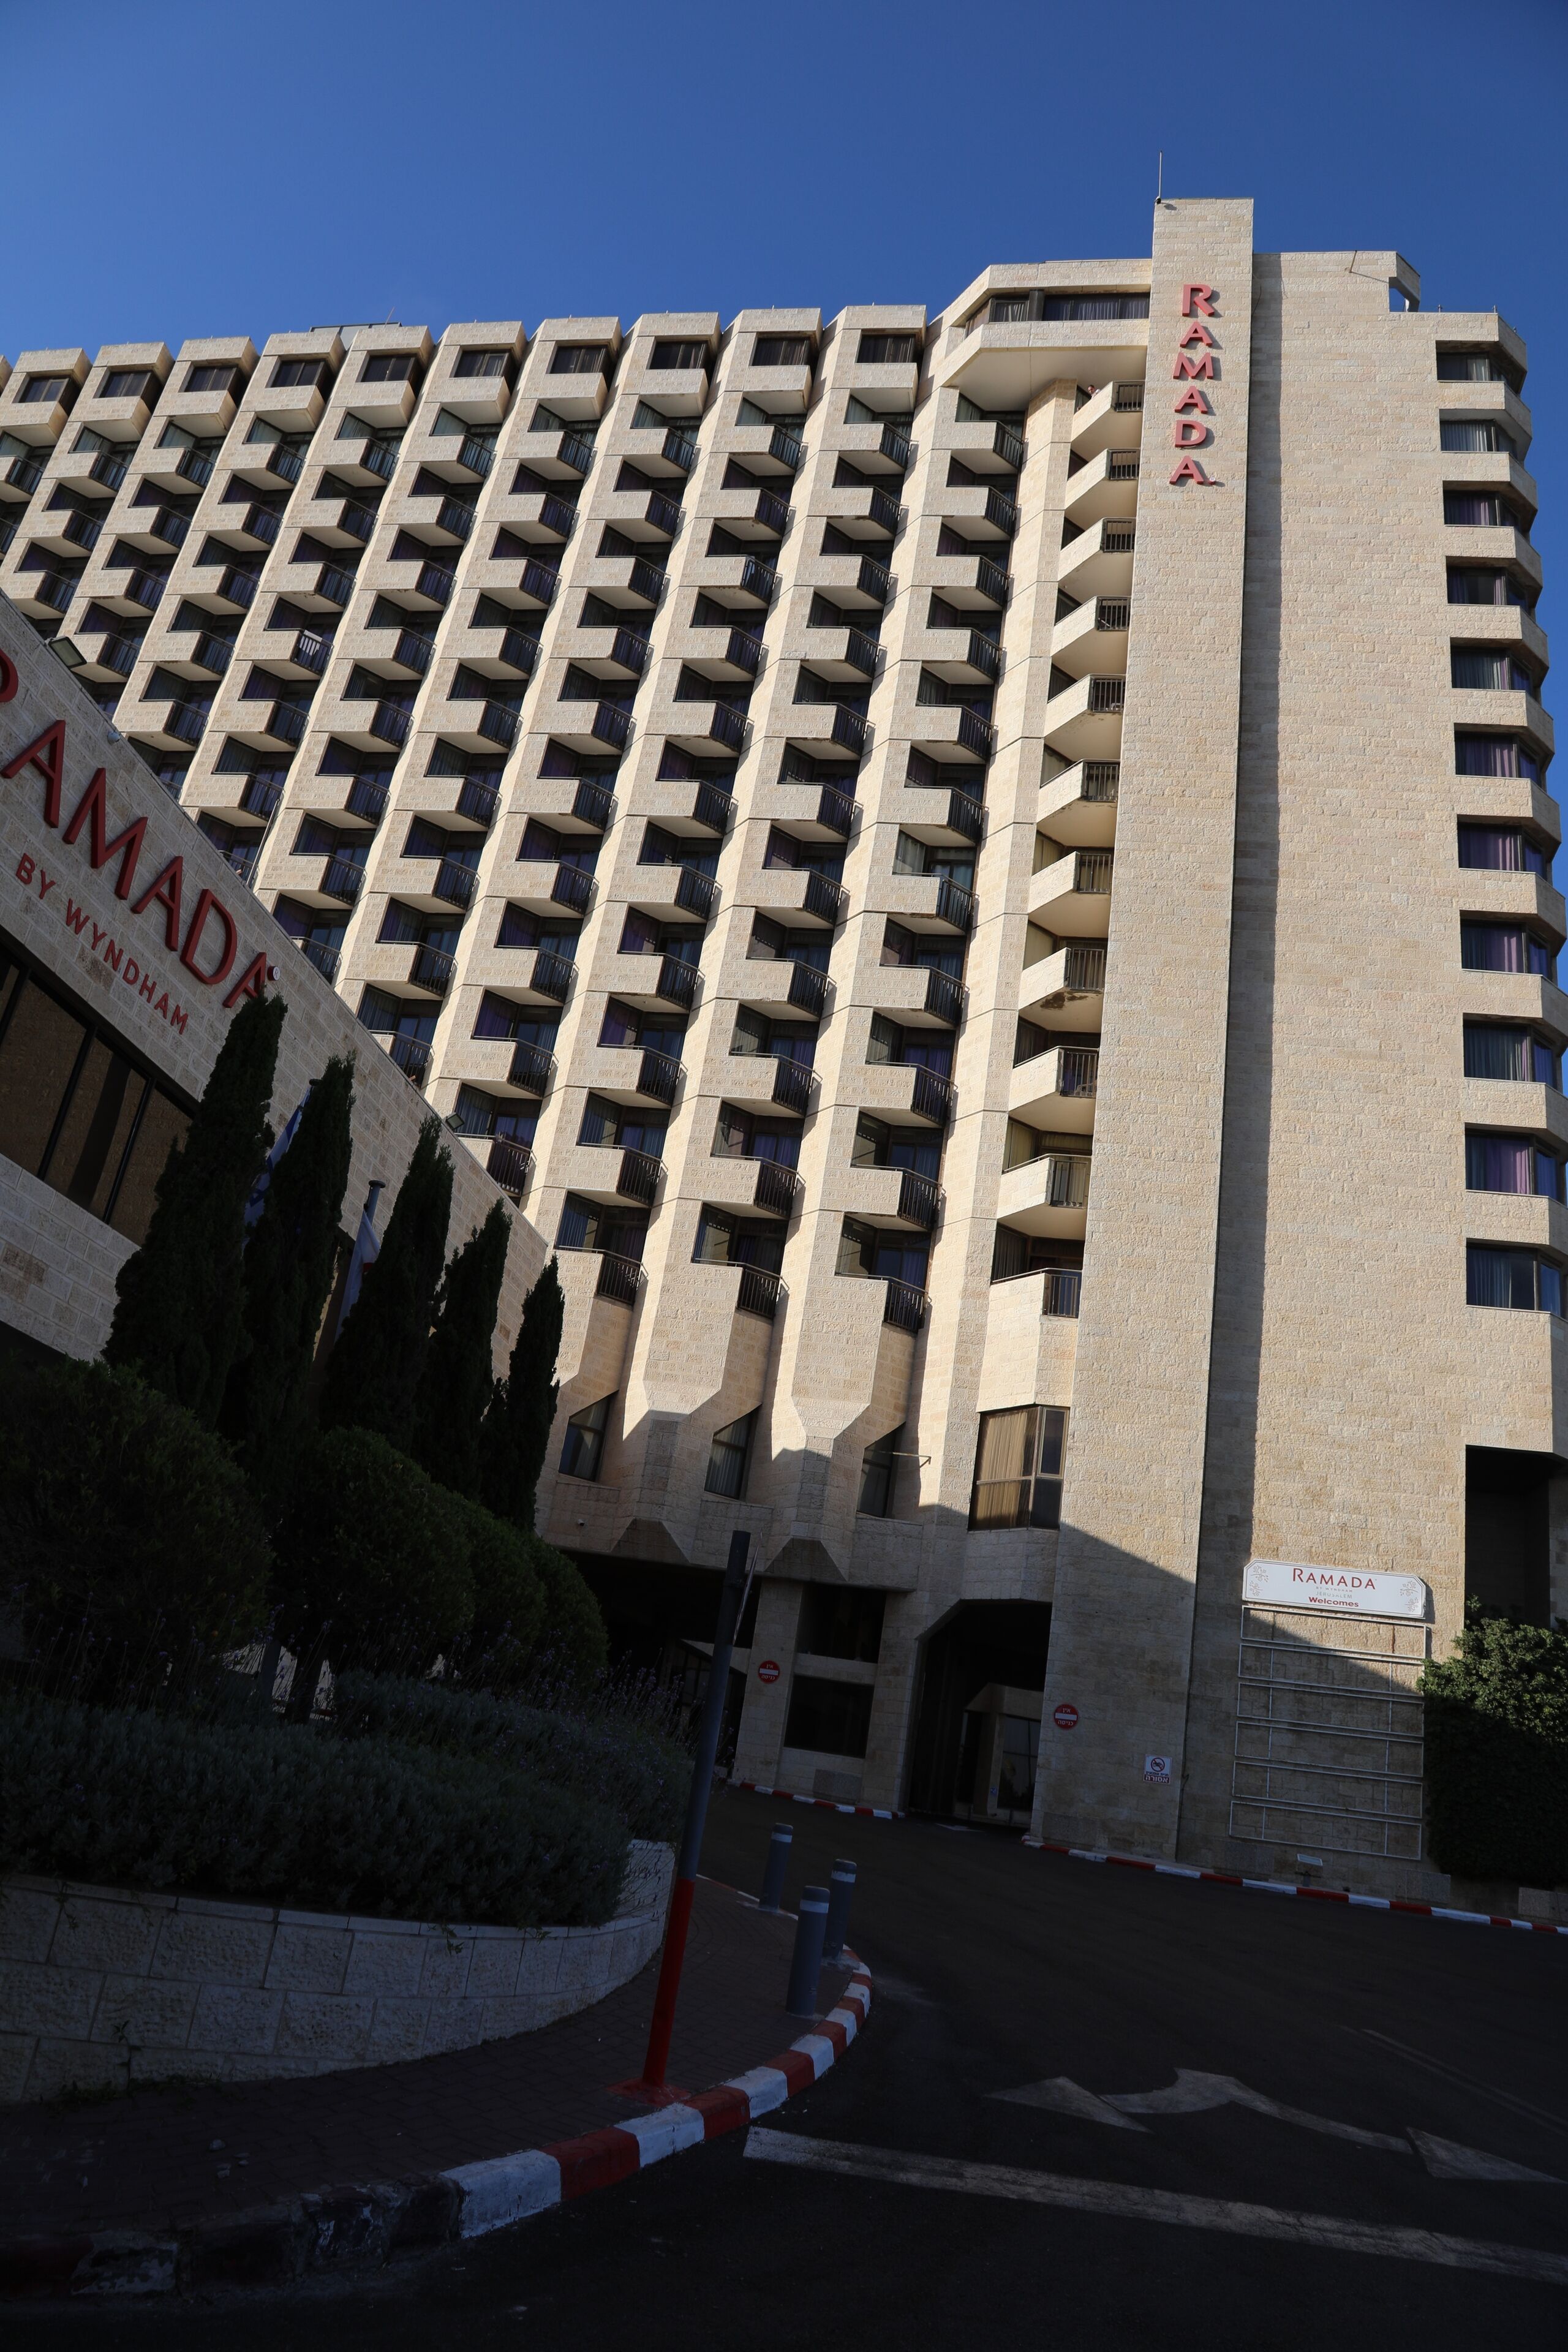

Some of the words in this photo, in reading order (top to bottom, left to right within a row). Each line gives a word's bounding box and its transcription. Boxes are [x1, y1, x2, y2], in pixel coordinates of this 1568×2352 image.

[0, 646, 267, 1008] AMADA
[16, 853, 56, 900] BY
[65, 898, 189, 1035] WYNDHAM
[1293, 1568, 1375, 1589] RAMADA
[1309, 1597, 1359, 1607] Welcomes
